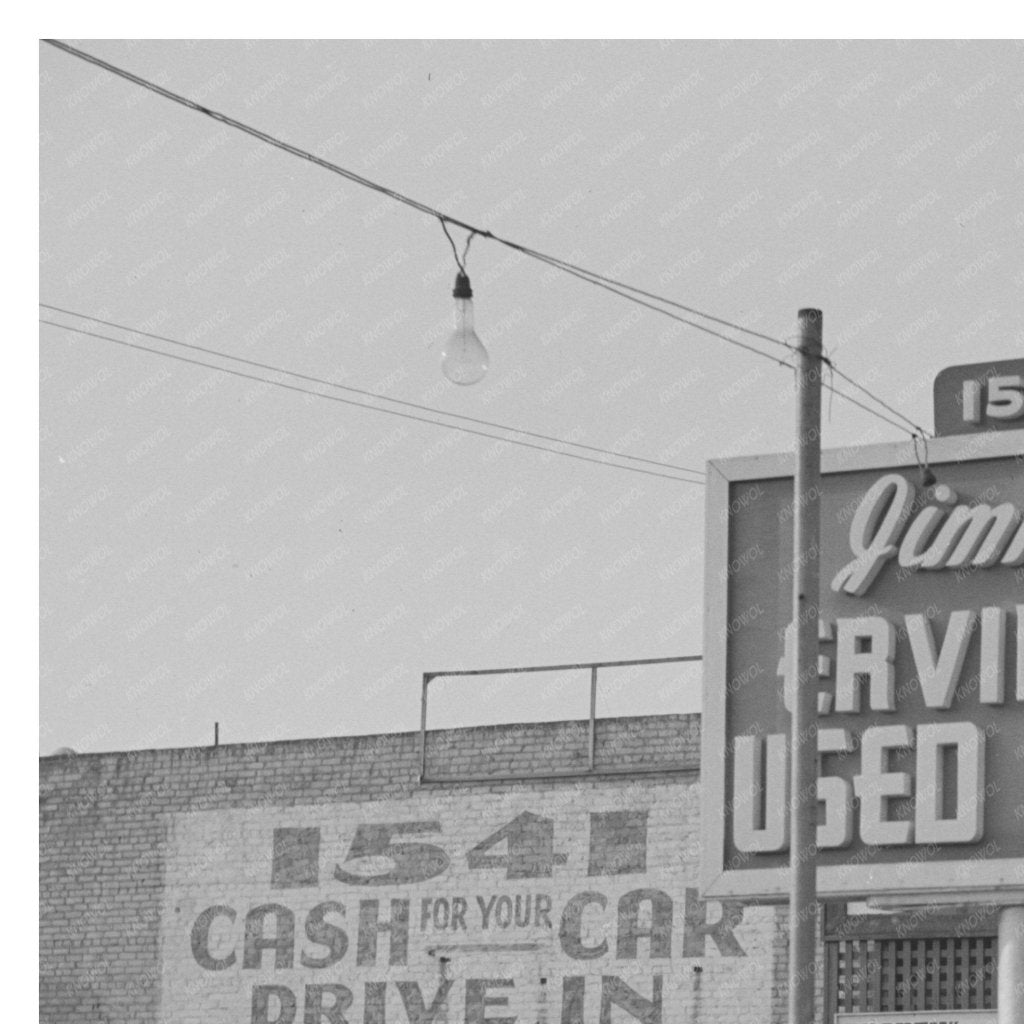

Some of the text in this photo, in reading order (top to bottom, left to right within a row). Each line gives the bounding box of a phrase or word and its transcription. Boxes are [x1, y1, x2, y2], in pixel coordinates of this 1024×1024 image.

[733, 721, 986, 853] USED
[270, 810, 648, 890] 1541
[190, 887, 748, 971] CASH FOR YOUR CAR
